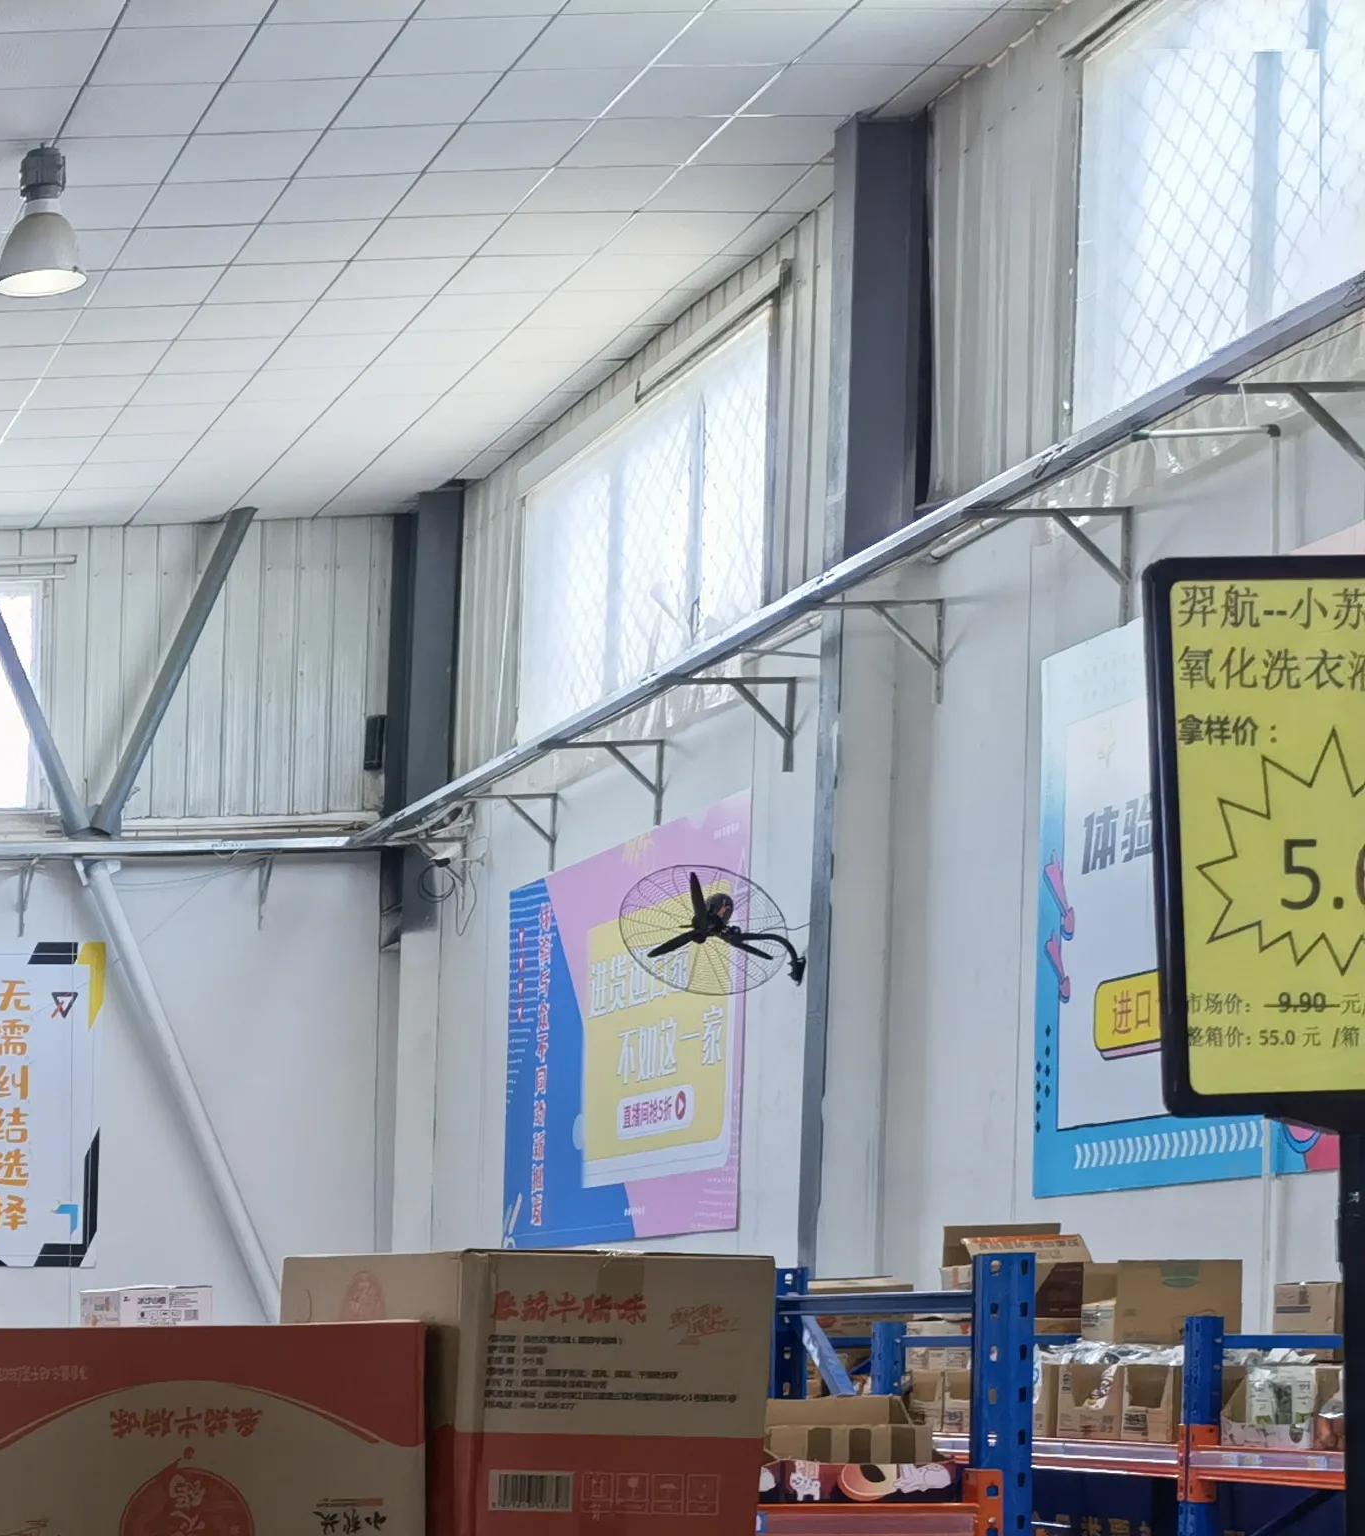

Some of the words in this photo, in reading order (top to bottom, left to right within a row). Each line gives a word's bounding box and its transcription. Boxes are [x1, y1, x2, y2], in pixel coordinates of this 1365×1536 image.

[616, 1005, 725, 1085] 不如这一家
[1259, 1029, 1296, 1046] 55.0
